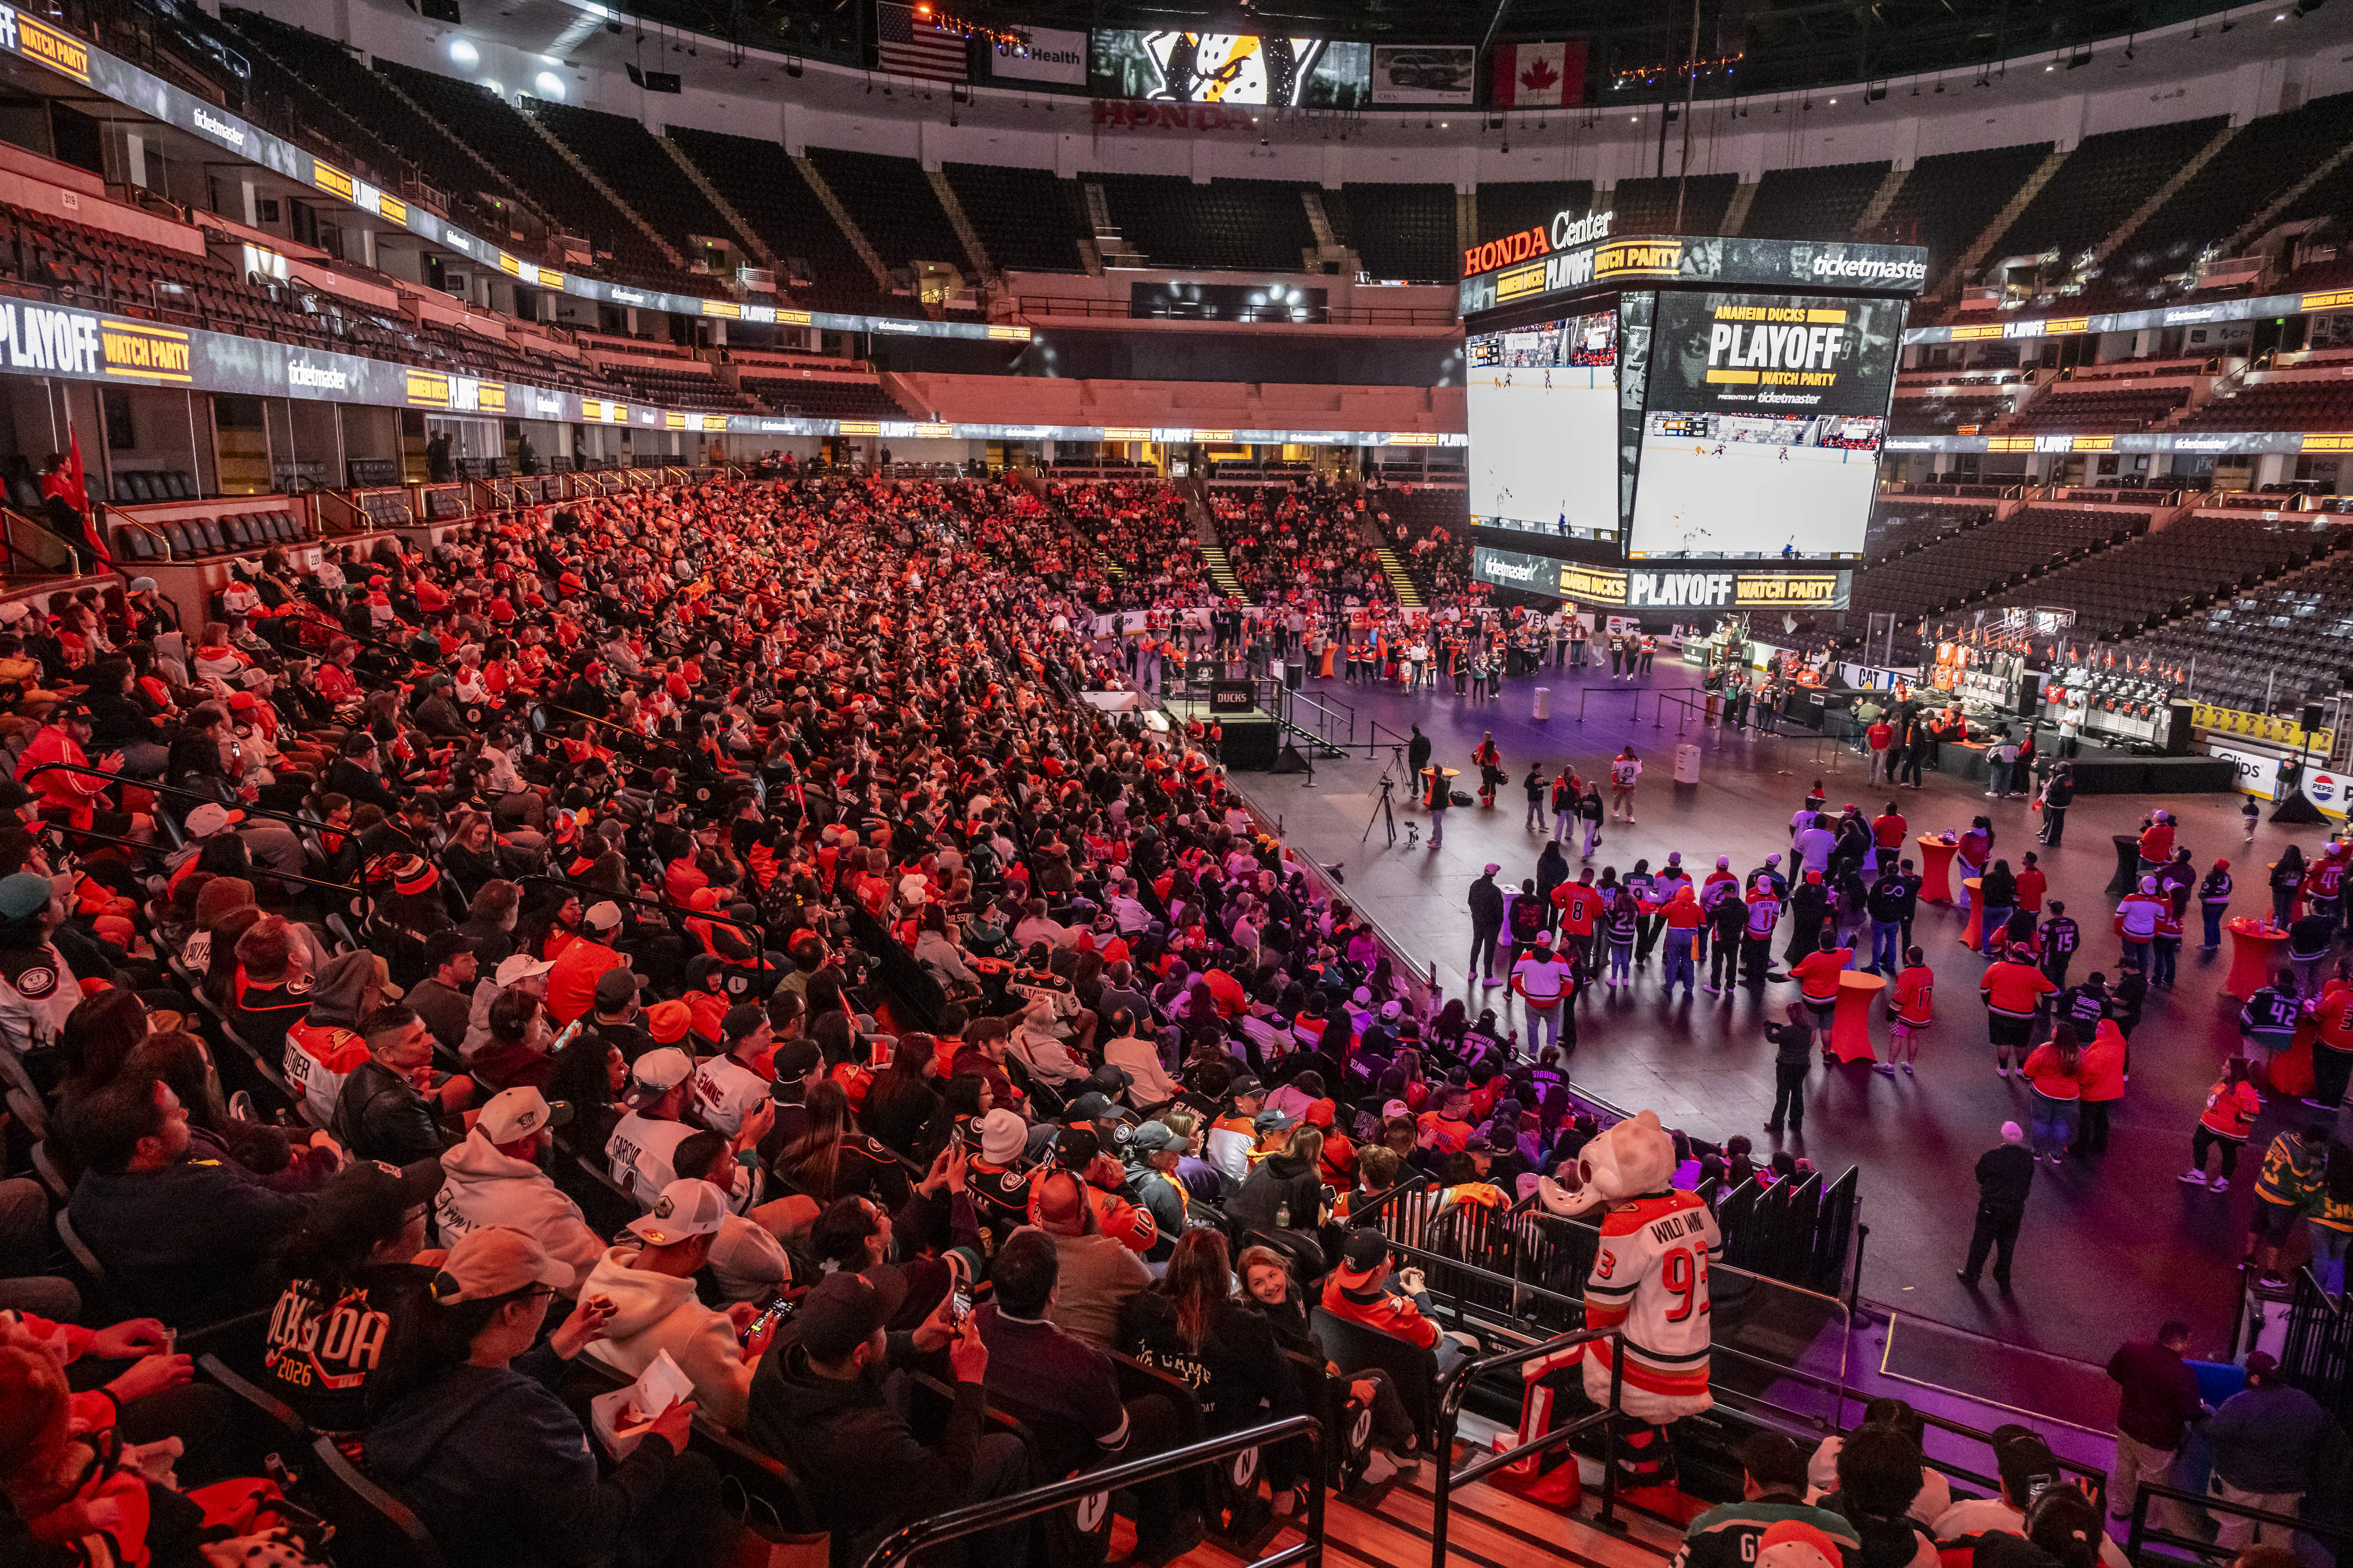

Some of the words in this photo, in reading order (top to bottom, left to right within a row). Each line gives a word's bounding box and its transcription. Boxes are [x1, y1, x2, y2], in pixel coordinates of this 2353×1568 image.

[19, 24, 58, 56] WATCH
[57, 41, 88, 74] PARTY
[1032, 48, 1081, 65] Health
[1092, 98, 1257, 131] HONDA
[194, 108, 244, 145] ticketmaster
[352, 178, 380, 213] PLAYOFF
[1464, 226, 1549, 276] HONDA
[1552, 209, 1612, 250] Center
[1497, 274, 1523, 295] ANAHEIM
[1524, 268, 1545, 291] DUCKS
[1545, 248, 1593, 291] PLAYOFF
[1595, 249, 1625, 272] WATCH
[1627, 248, 1681, 268] PARTY
[1813, 253, 1927, 280] ticketmaster
[2301, 295, 2334, 307] ANAHEIM
[741, 305, 776, 322] PLAYOFF
[1715, 306, 1765, 321] ANAHEIM
[1767, 308, 1805, 322] DUCKS
[1981, 327, 2002, 336] DUCKS
[2004, 321, 2045, 338] PLAYOFF
[2070, 320, 2088, 330] PARTY
[102, 332, 148, 366] WATCH
[150, 339, 189, 371] PARTY
[1708, 323, 1844, 369] PLAYOFF
[288, 359, 347, 389] ticketmaster
[1762, 371, 1798, 386] WATCH
[1800, 372, 1837, 386] PARTY
[448, 376, 478, 411] PLAYOFF
[1758, 392, 1821, 405] ticketmaster
[880, 422, 915, 436] PLAYOFF
[1151, 429, 1192, 442] PLAYOFF
[2035, 436, 2072, 452] PLAYOFF
[2094, 439, 2114, 448] PARTY
[2175, 438, 2228, 449] ticketmaster
[311, 555, 320, 565] 220
[1485, 558, 1529, 581] ticketmaster
[1560, 572, 1591, 592] ANAHEIM
[1591, 576, 1627, 598] DUCKS
[1631, 574, 1732, 605] PLAYOFF
[1737, 581, 1788, 599] WATCH
[1788, 581, 1835, 599] PARTY
[1479, 608, 1548, 625] DVER
[1614, 643, 1622, 651] 15
[1858, 669, 1881, 689] CAT
[1217, 693, 1247, 703] DUCKS
[2312, 783, 2334, 793] PEPSI
[1572, 899, 1584, 921] 8
[1764, 909, 1768, 928] 1
[994, 943, 1007, 956] 61
[2058, 932, 2074, 952] 15
[735, 978, 741, 990] L
[1070, 997, 1076, 1008] 3
[1919, 987, 1932, 1008] 17
[2270, 1002, 2298, 1027] 42
[1458, 1038, 1488, 1067] 27
[1349, 1058, 1371, 1078] SELANNE
[1532, 1070, 1561, 1083] GIGUERE
[1419, 1122, 1454, 1146] SENNE
[613, 1134, 642, 1167] GARCIA
[1133, 1212, 1153, 1238] 10
[1649, 1216, 1684, 1245] WILD
[1594, 1247, 1617, 1280] 3
[1662, 1241, 1710, 1323] 93
[277, 1356, 313, 1387] 2026
[1358, 1420, 1367, 1437] M
[1241, 1449, 1251, 1478] N
[1088, 1494, 1098, 1522] P
